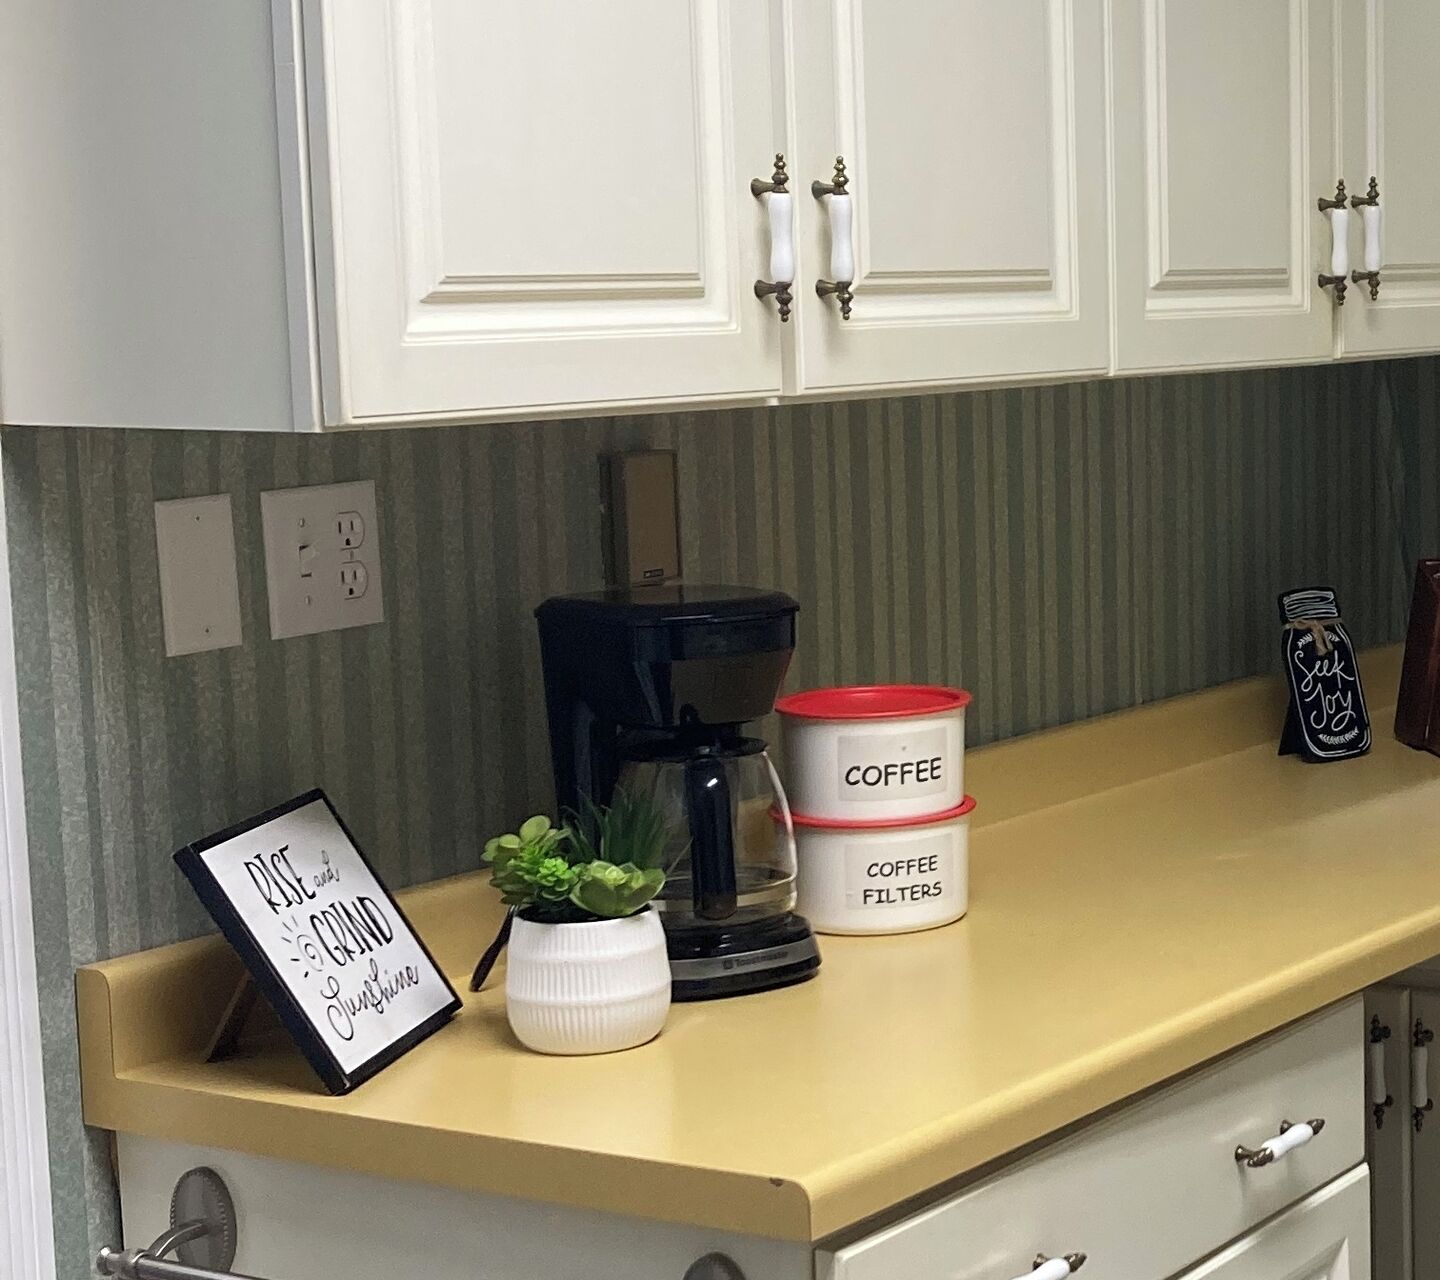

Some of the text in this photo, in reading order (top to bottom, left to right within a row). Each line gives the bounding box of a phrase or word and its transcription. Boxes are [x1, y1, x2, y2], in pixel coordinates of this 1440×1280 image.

[1294, 650, 1355, 692] Seek
[1304, 682, 1356, 731] Joy
[845, 757, 942, 787] COFFEE
[243, 844, 340, 915] RISE and
[866, 855, 939, 878] COFFEE
[863, 881, 942, 905] FILTERS
[309, 896, 393, 967] GRIND
